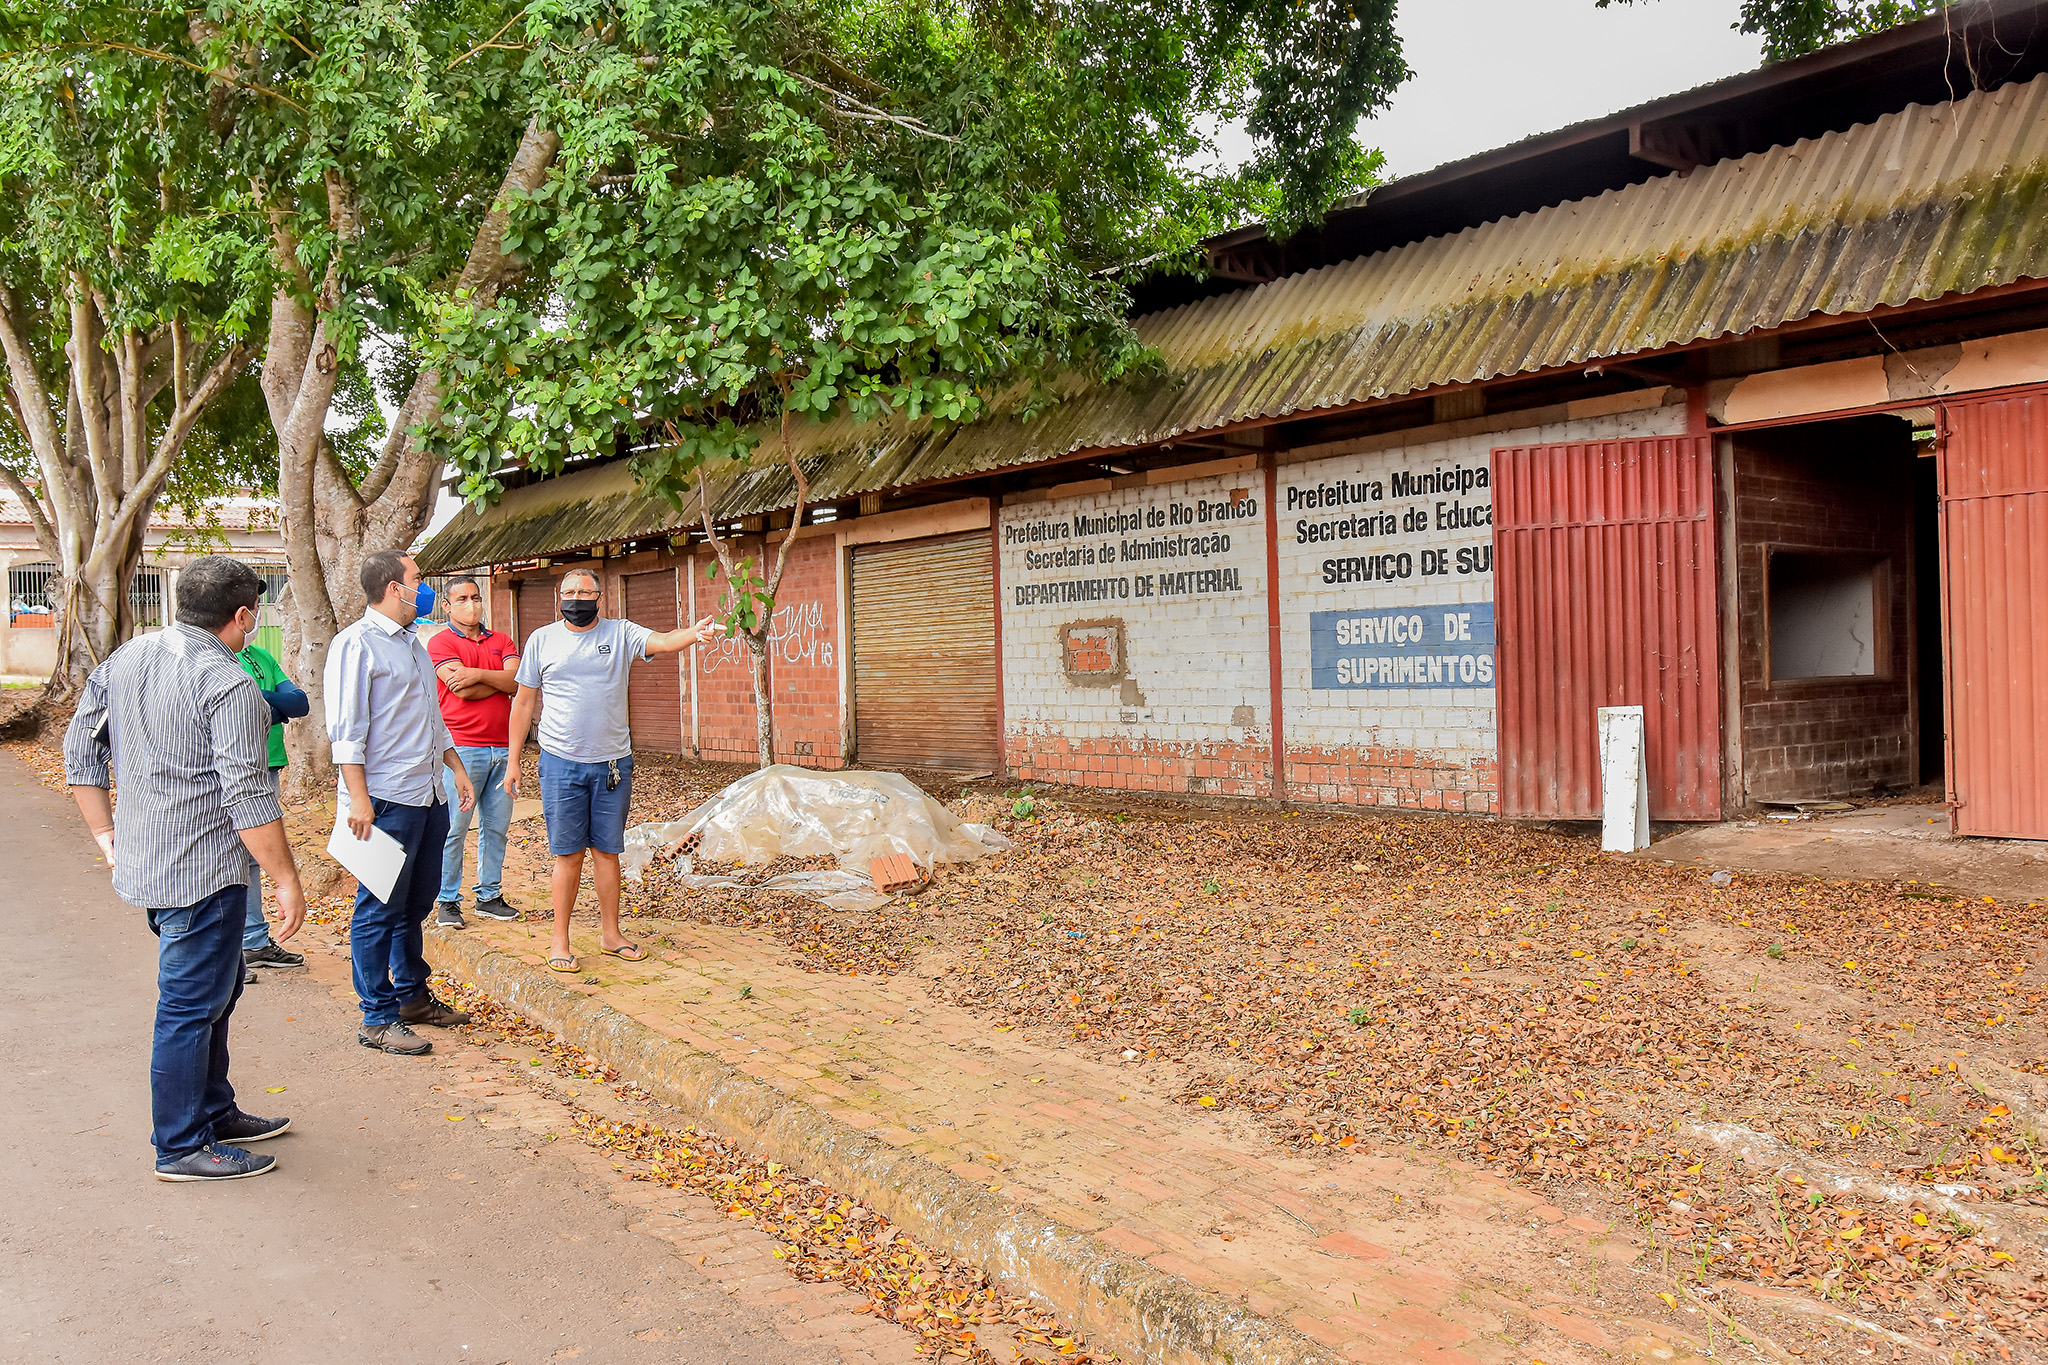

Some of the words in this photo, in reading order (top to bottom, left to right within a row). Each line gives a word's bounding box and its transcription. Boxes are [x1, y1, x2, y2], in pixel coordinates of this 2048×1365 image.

[1287, 479, 1384, 511] Prefeitura
[1391, 464, 1492, 499] Municipa
[1005, 520, 1070, 545] Prefeitura
[1074, 507, 1142, 536] Municipal
[1146, 506, 1166, 528] de
[1169, 502, 1193, 526] Rio
[1198, 499, 1257, 523] Branco
[1296, 510, 1397, 544] Secretaria
[1402, 506, 1428, 533] de
[1026, 544, 1095, 571] Secretaria
[1098, 542, 1116, 564] de
[1120, 532, 1231, 562] Administração
[1322, 552, 1413, 584] SERVIÇO
[1420, 548, 1449, 576] DE
[1456, 545, 1494, 574] SU
[1015, 577, 1130, 606] DEPARTAMENTO
[1135, 575, 1154, 598] DE
[1159, 567, 1242, 596] MATERIAL
[1336, 614, 1424, 647] SERVIÇO
[1443, 612, 1472, 641] DE
[1336, 654, 1494, 685] SUPRIMENTOS
